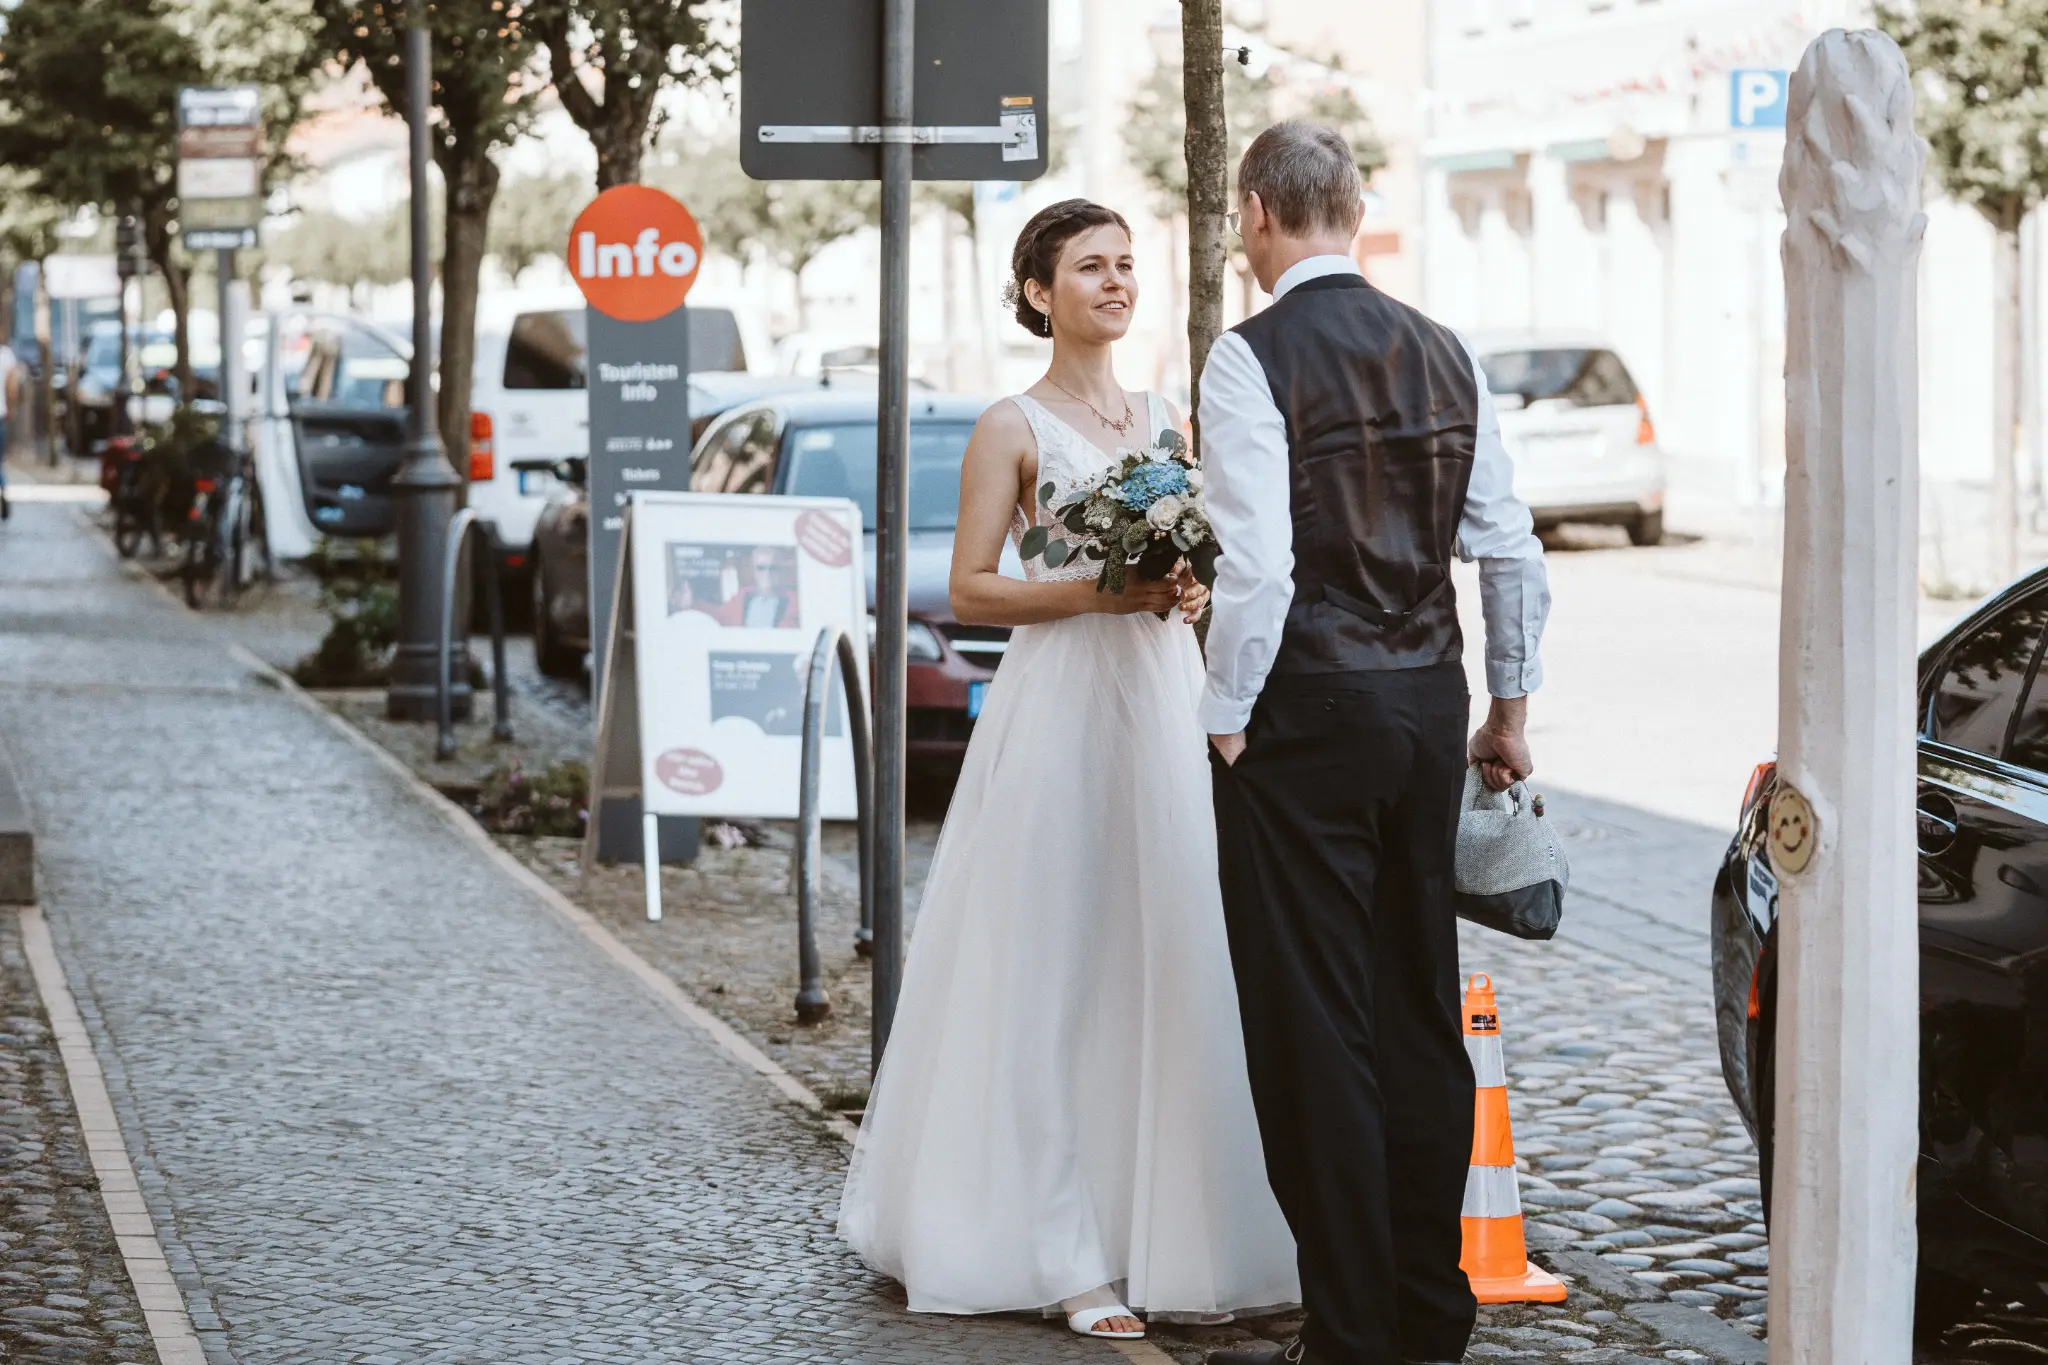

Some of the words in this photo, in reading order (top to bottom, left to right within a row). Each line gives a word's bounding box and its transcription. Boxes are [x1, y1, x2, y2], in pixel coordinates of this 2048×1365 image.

[1738, 71, 1778, 125] P
[577, 228, 697, 278] Info
[599, 362, 679, 382] Touristen
[620, 382, 658, 402] Info
